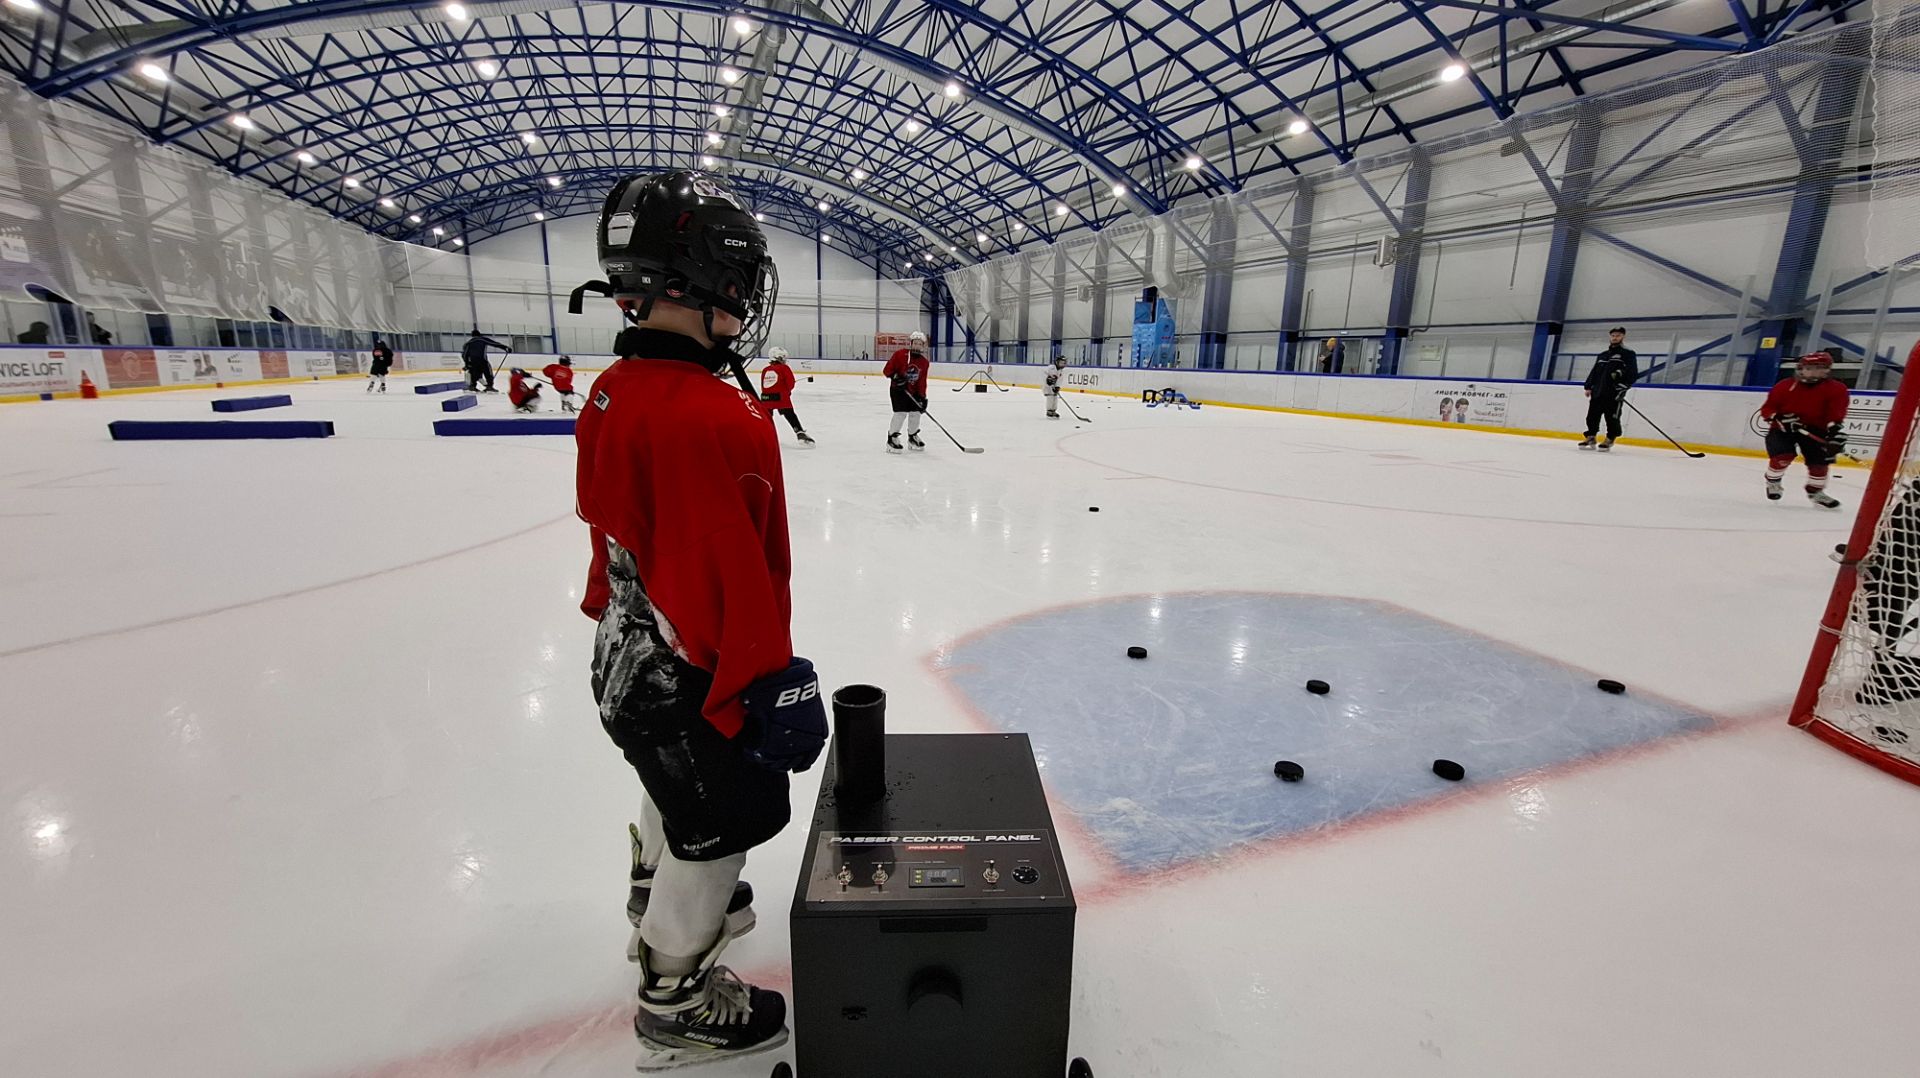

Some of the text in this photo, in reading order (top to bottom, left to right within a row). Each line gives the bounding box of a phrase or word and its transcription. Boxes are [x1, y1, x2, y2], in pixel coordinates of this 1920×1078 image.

[724, 238, 748, 248] CCM
[32, 363, 63, 376] LOFT
[1067, 373, 1089, 385] CLUB
[902, 834, 981, 843] CONTROL
[984, 834, 1041, 842] PANEL
